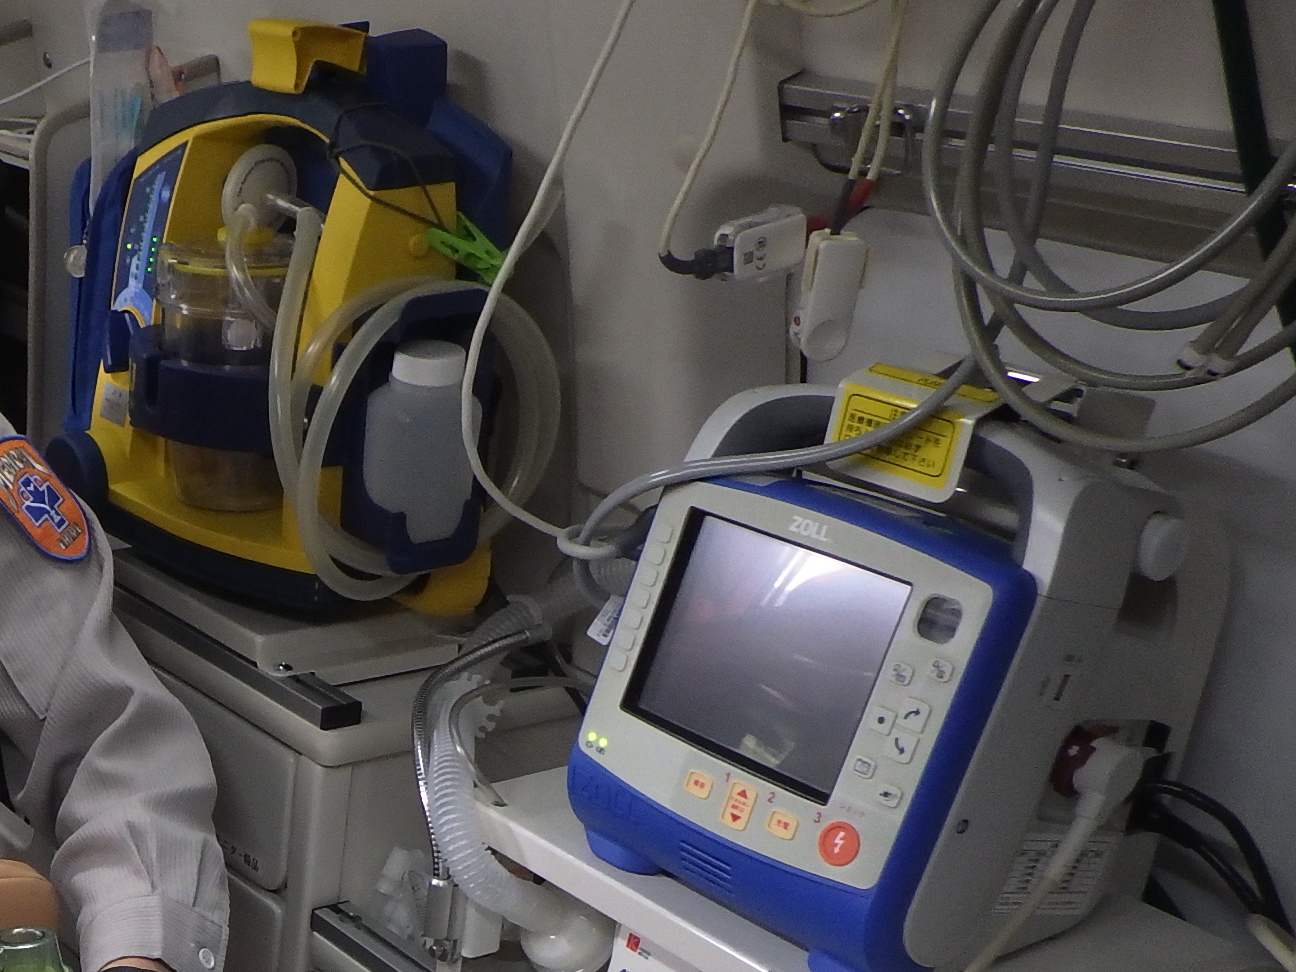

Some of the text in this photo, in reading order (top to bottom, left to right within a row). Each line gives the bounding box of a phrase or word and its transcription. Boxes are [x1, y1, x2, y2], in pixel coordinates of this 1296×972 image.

[788, 515, 829, 542] ZOLL
[725, 772, 731, 783] 1
[767, 791, 776, 803] 2
[813, 811, 822, 823] 3
